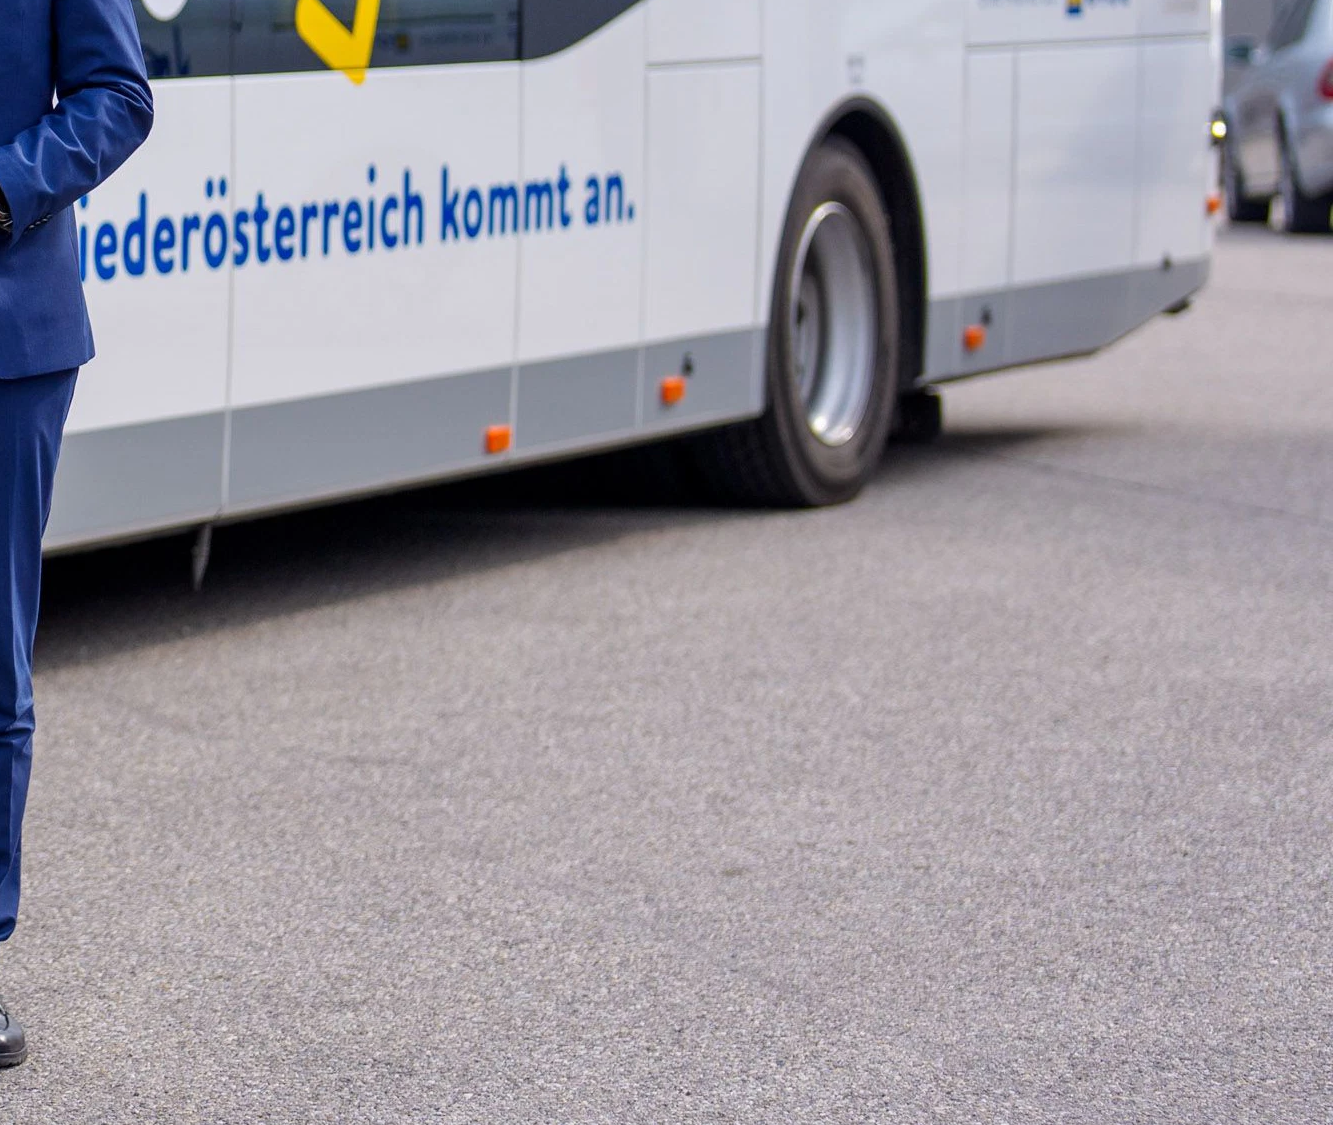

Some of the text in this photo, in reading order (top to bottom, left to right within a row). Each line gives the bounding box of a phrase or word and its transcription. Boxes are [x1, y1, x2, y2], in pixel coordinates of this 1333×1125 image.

[79, 163, 636, 283] iederösterreich kommt an.
